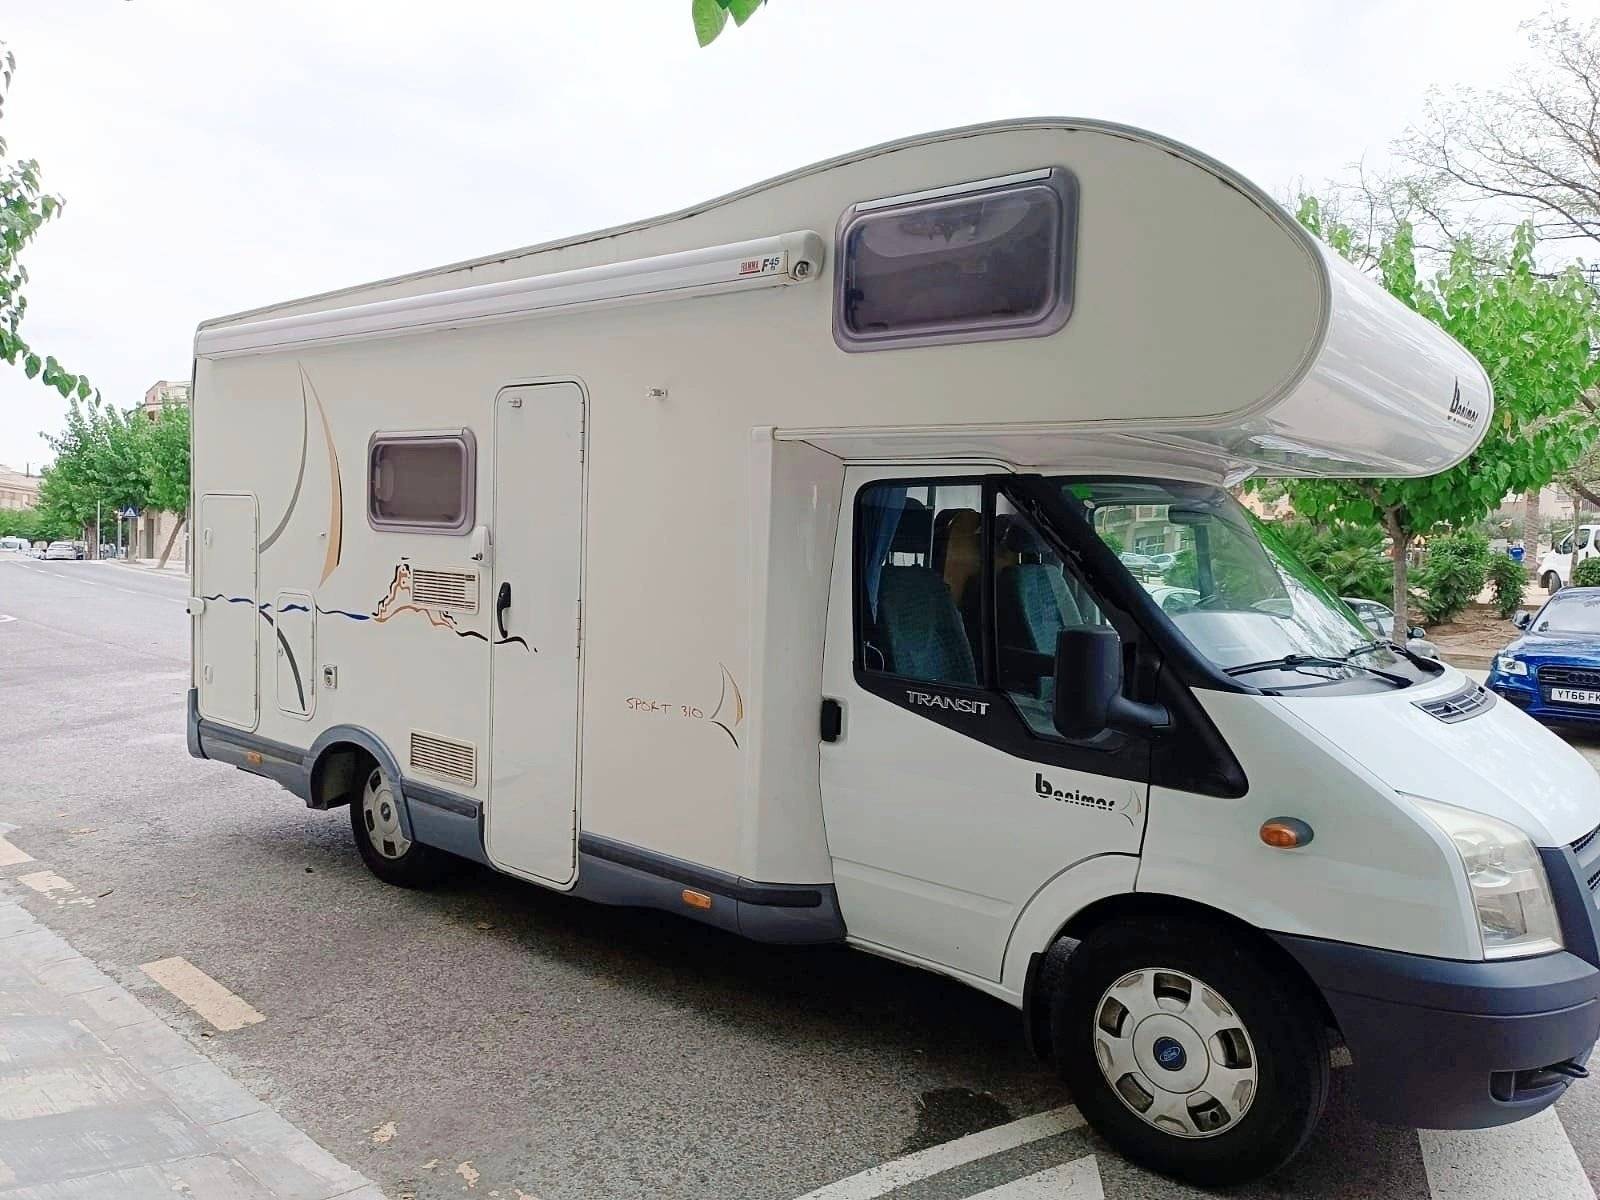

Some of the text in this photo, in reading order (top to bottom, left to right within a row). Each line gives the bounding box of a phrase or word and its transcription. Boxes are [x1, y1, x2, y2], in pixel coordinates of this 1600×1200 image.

[906, 690, 991, 716] TRANSIT
[1558, 690, 1585, 701] YT66
[626, 697, 704, 719] SPORT 310
